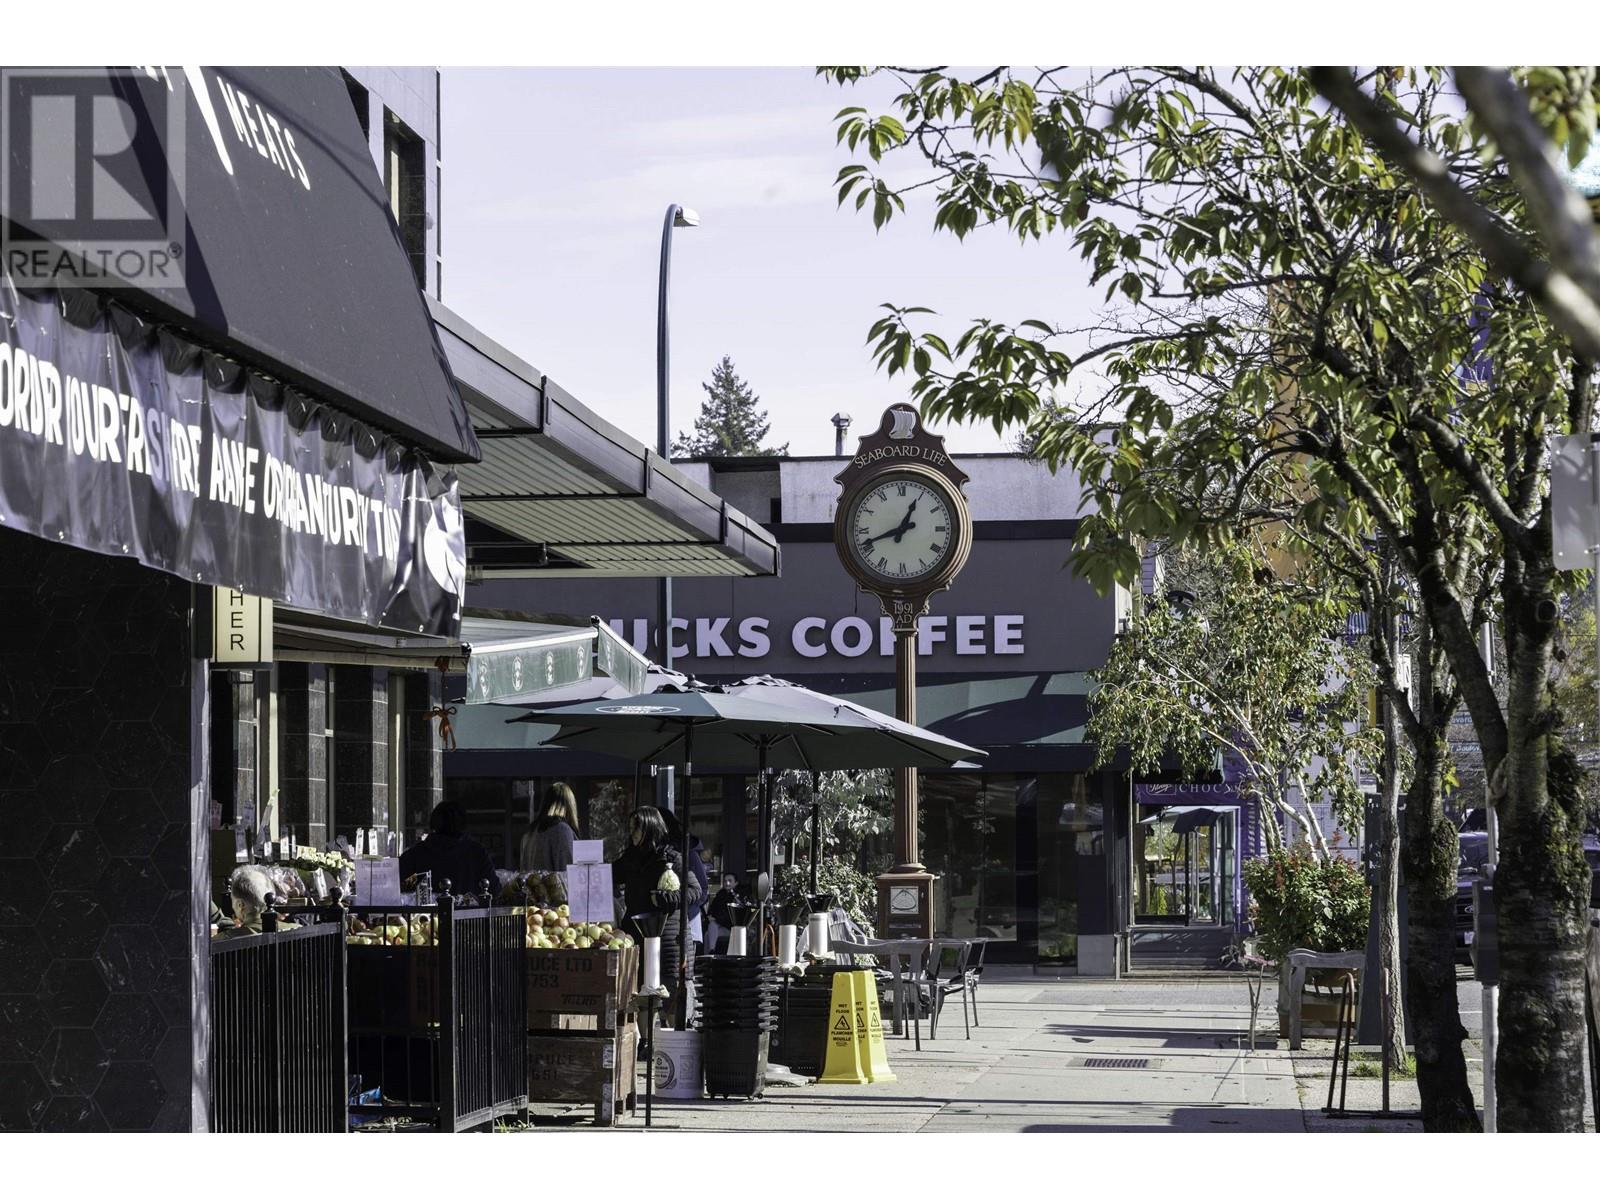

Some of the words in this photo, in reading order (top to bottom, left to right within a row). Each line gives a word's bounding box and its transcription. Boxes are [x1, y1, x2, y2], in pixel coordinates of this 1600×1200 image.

[217, 76, 311, 191] MEATS
[854, 446, 920, 469] SEABOARD
[922, 448, 948, 467] LIFE
[894, 602, 914, 614] 1991
[230, 590, 244, 651] HER
[608, 616, 771, 658] UCKS
[529, 957, 560, 972] UCE
[565, 957, 592, 973] LTD
[527, 974, 559, 988] 753
